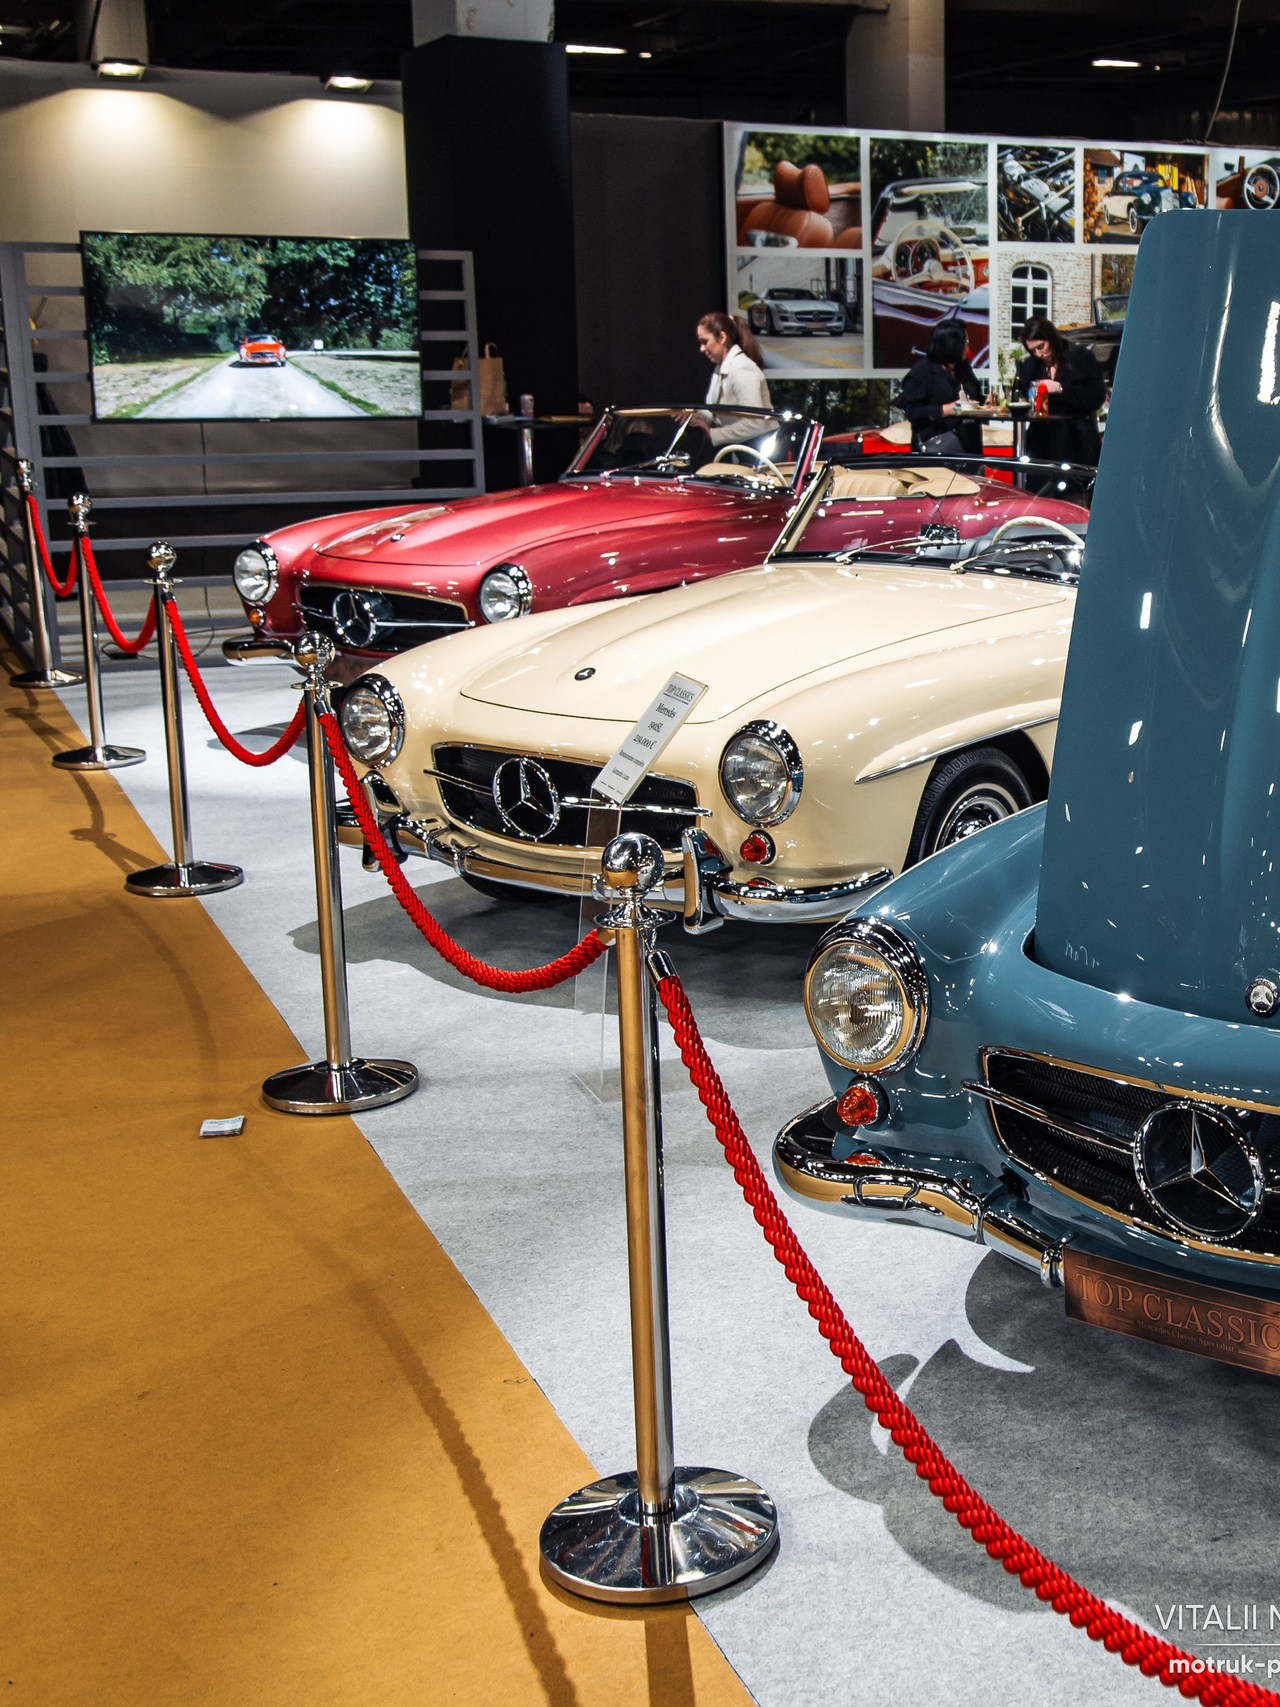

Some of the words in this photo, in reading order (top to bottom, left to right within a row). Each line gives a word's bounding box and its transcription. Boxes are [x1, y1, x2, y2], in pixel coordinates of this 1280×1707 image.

[655, 702, 677, 719] Mercedes
[1075, 1273, 1134, 1312] TOP
[1137, 1319, 1171, 1336] Mercedes
[1172, 1331, 1197, 1343] Classic
[1199, 1338, 1235, 1353] Specialist
